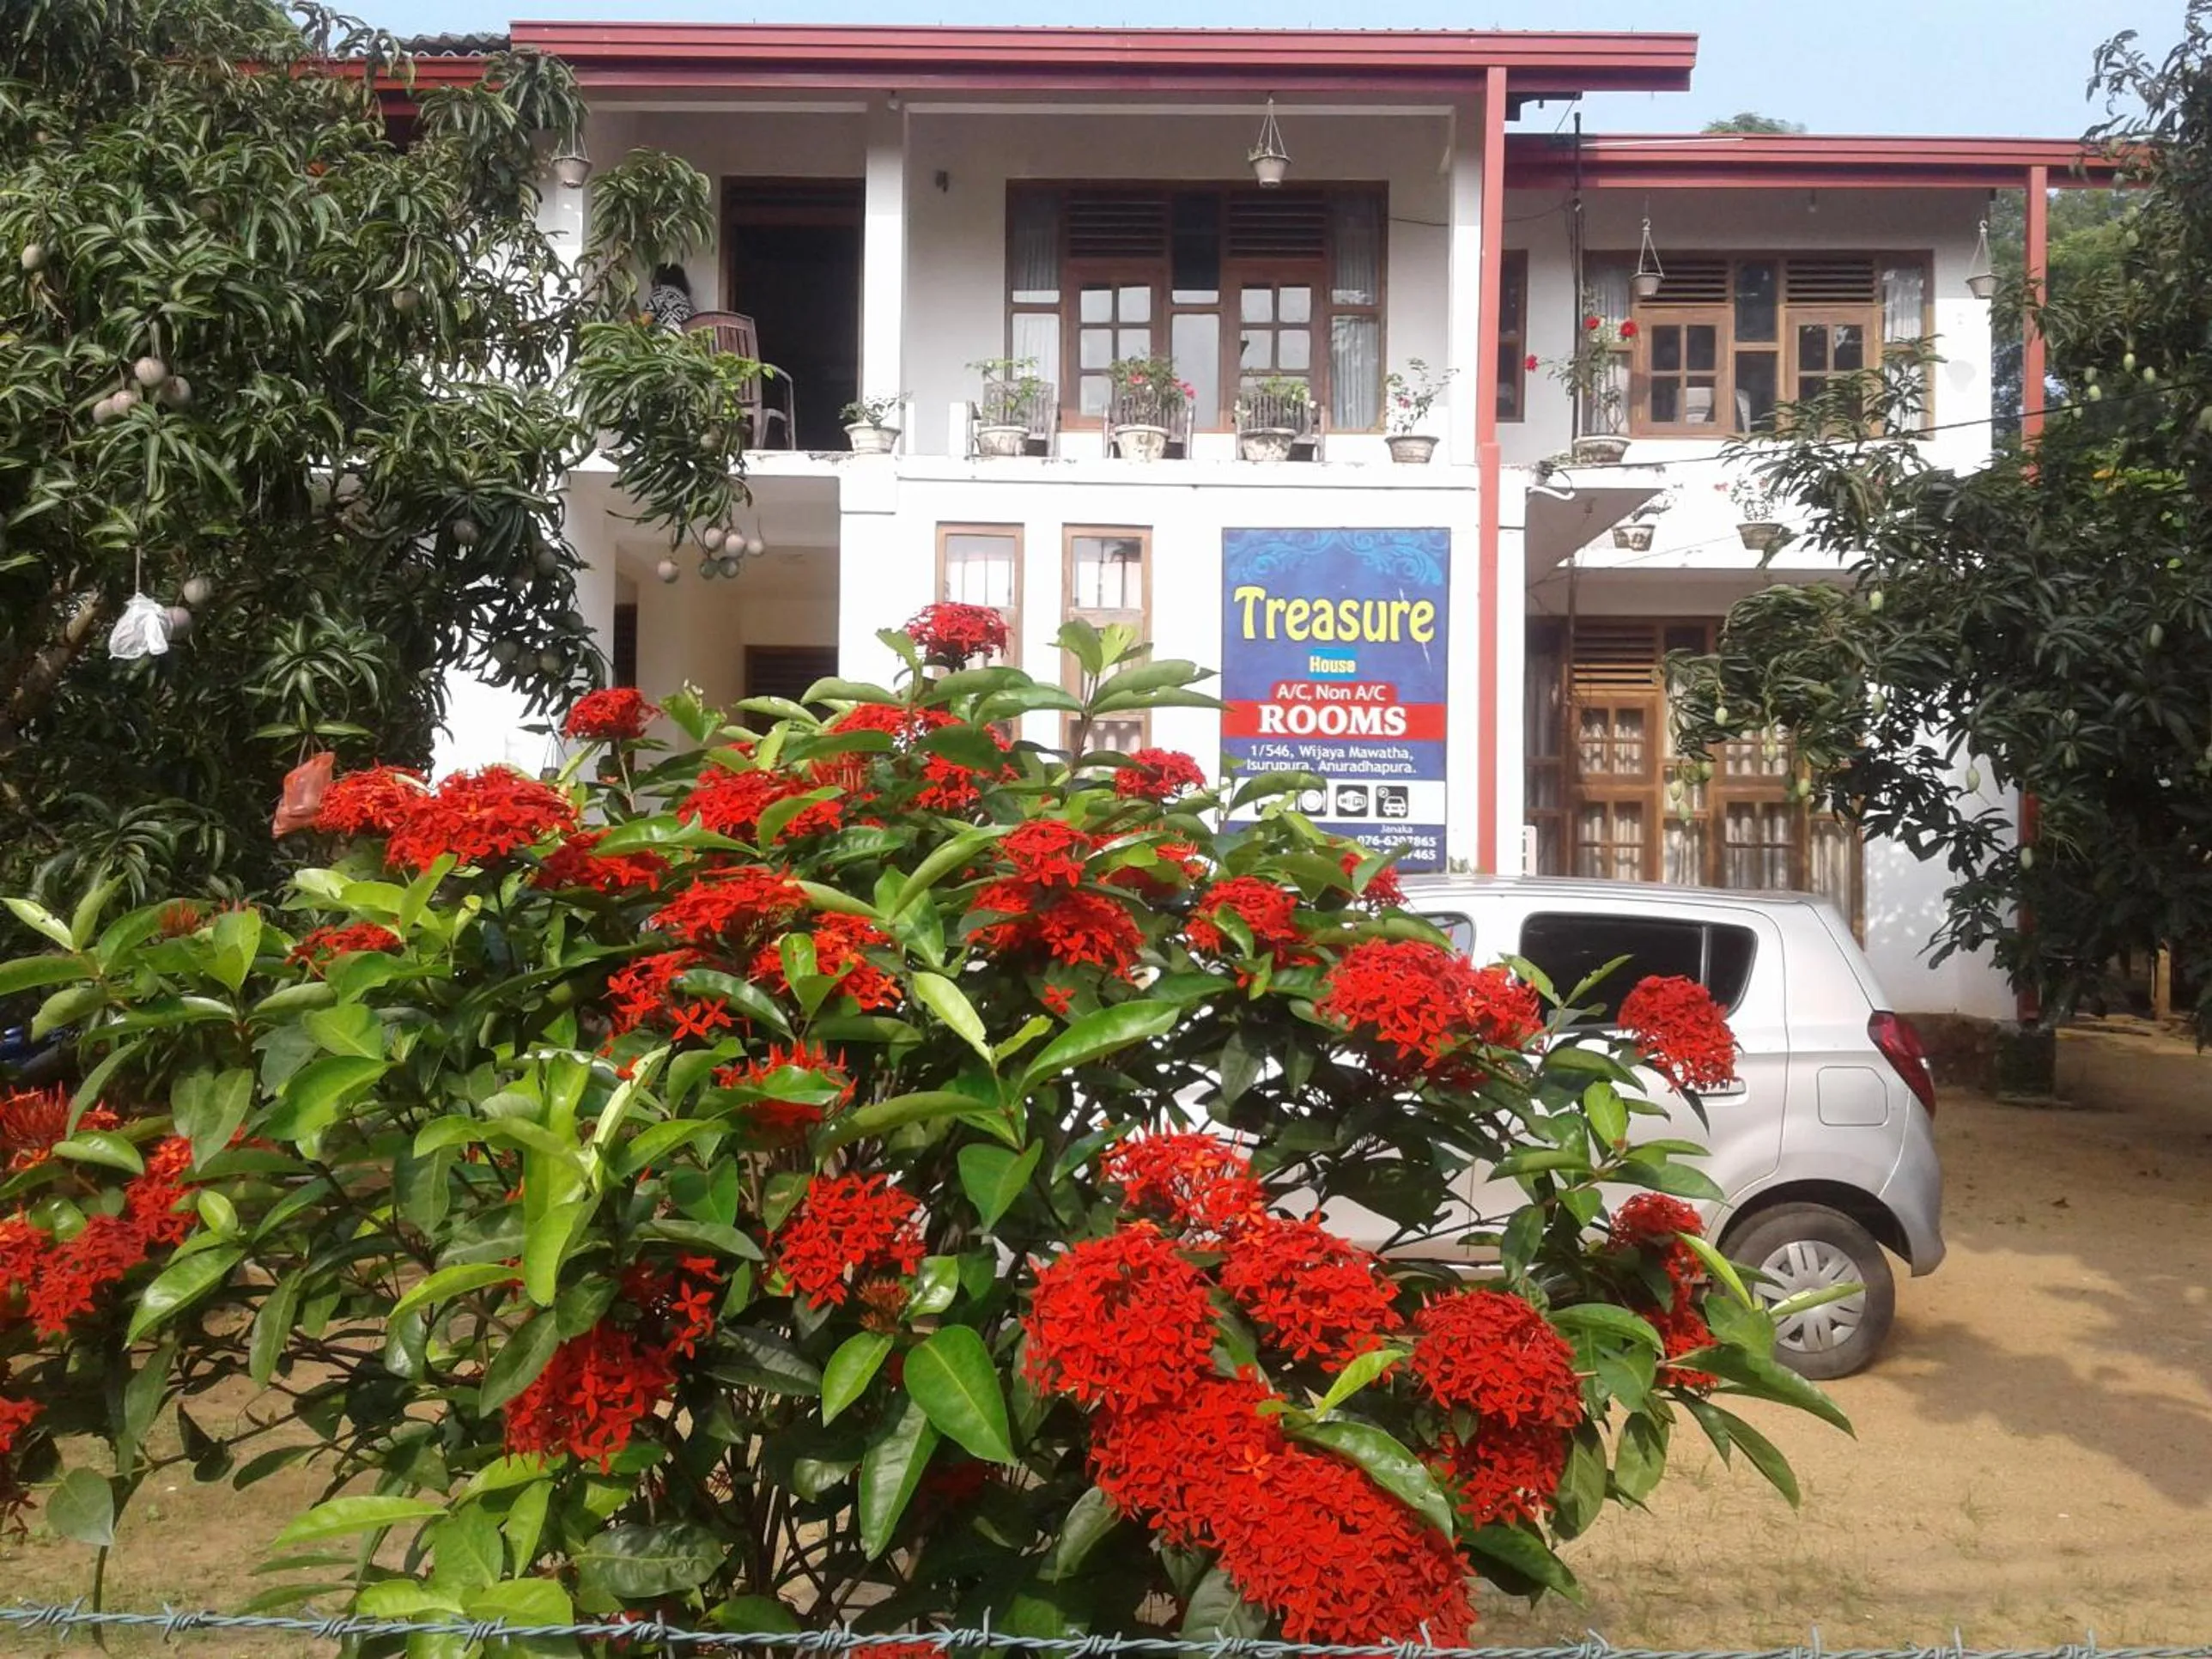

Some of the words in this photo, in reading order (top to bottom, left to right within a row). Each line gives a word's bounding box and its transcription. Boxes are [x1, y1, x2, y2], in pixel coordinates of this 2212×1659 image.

[1234, 586, 1435, 642] Treasure
[1310, 655, 1356, 672] House
[1316, 686, 1351, 700] Non
[1354, 685, 1385, 701] A/C
[1258, 704, 1407, 736] ROOMS
[1250, 744, 1294, 759] 1/546,
[1298, 744, 1345, 760] Wijaya
[1349, 746, 1414, 760] Mawatha,
[1318, 760, 1417, 775] Anuradhapura.
[1381, 824, 1413, 834] Janaka
